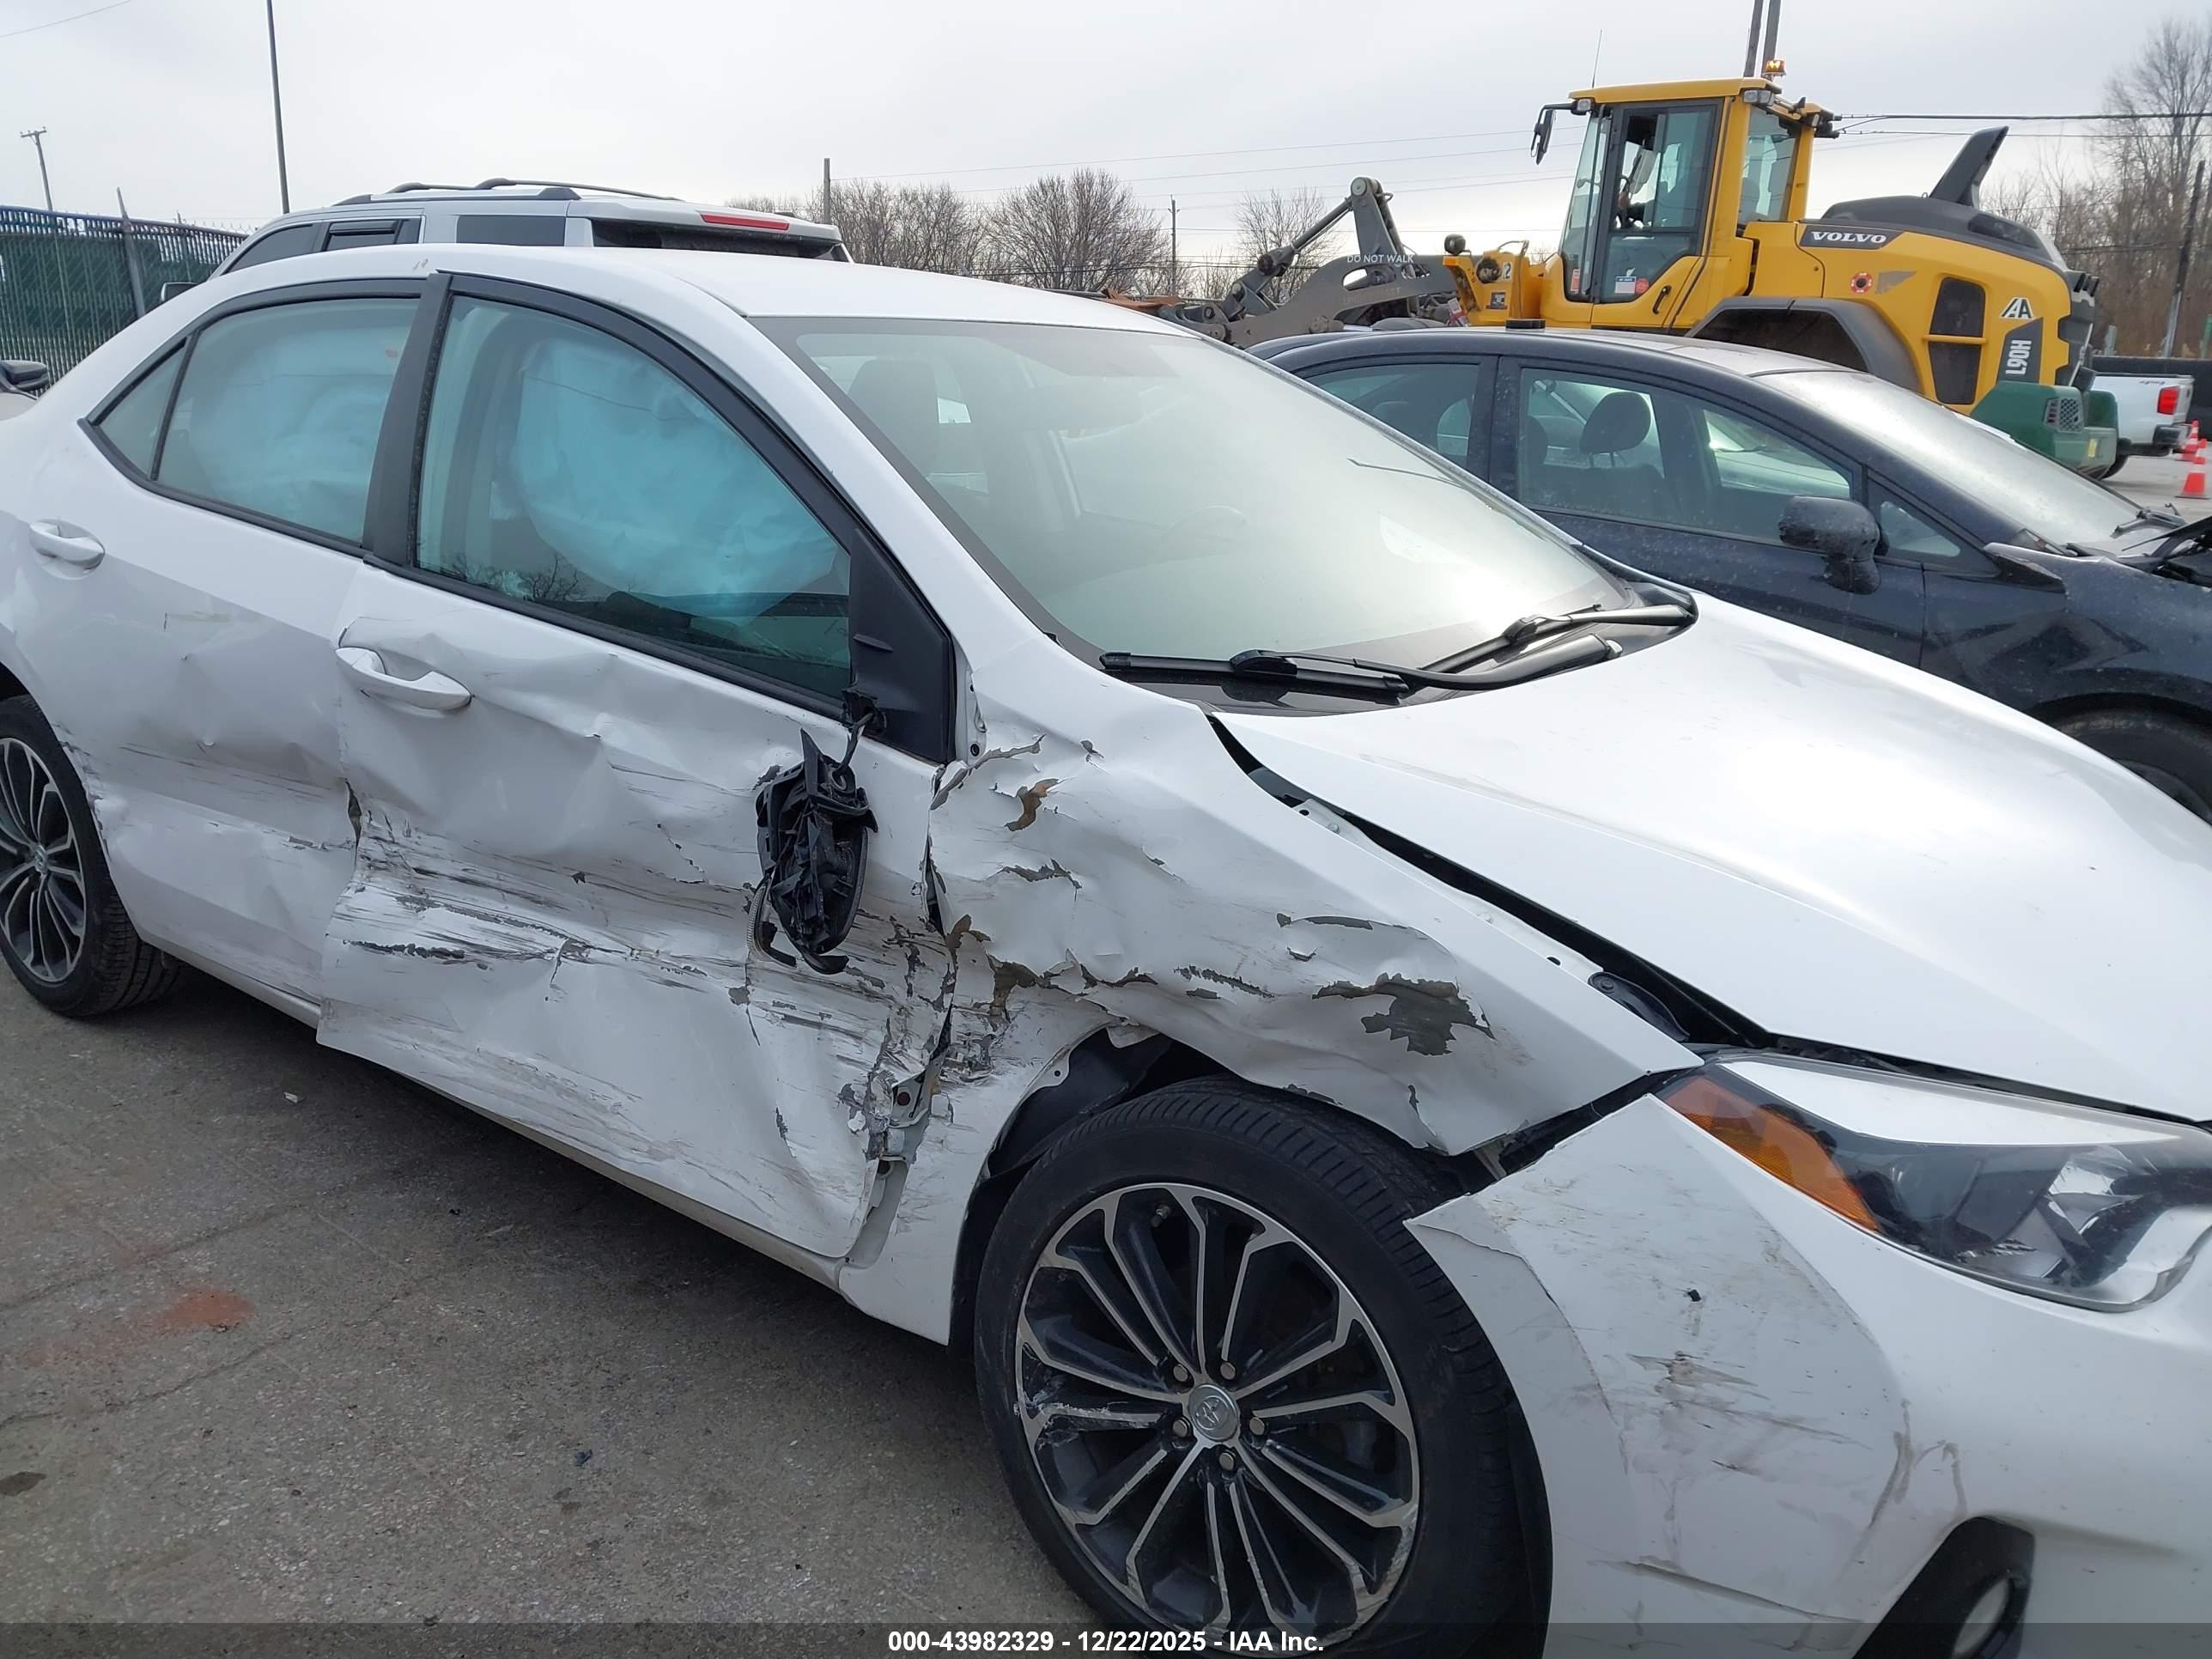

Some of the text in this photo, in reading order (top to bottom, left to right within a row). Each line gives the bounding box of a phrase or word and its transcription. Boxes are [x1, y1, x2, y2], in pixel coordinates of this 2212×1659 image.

[1811, 231, 1887, 244] VOLVO
[1346, 254, 1414, 263] DO NOT WALK
[2005, 339, 2033, 375] L90H
